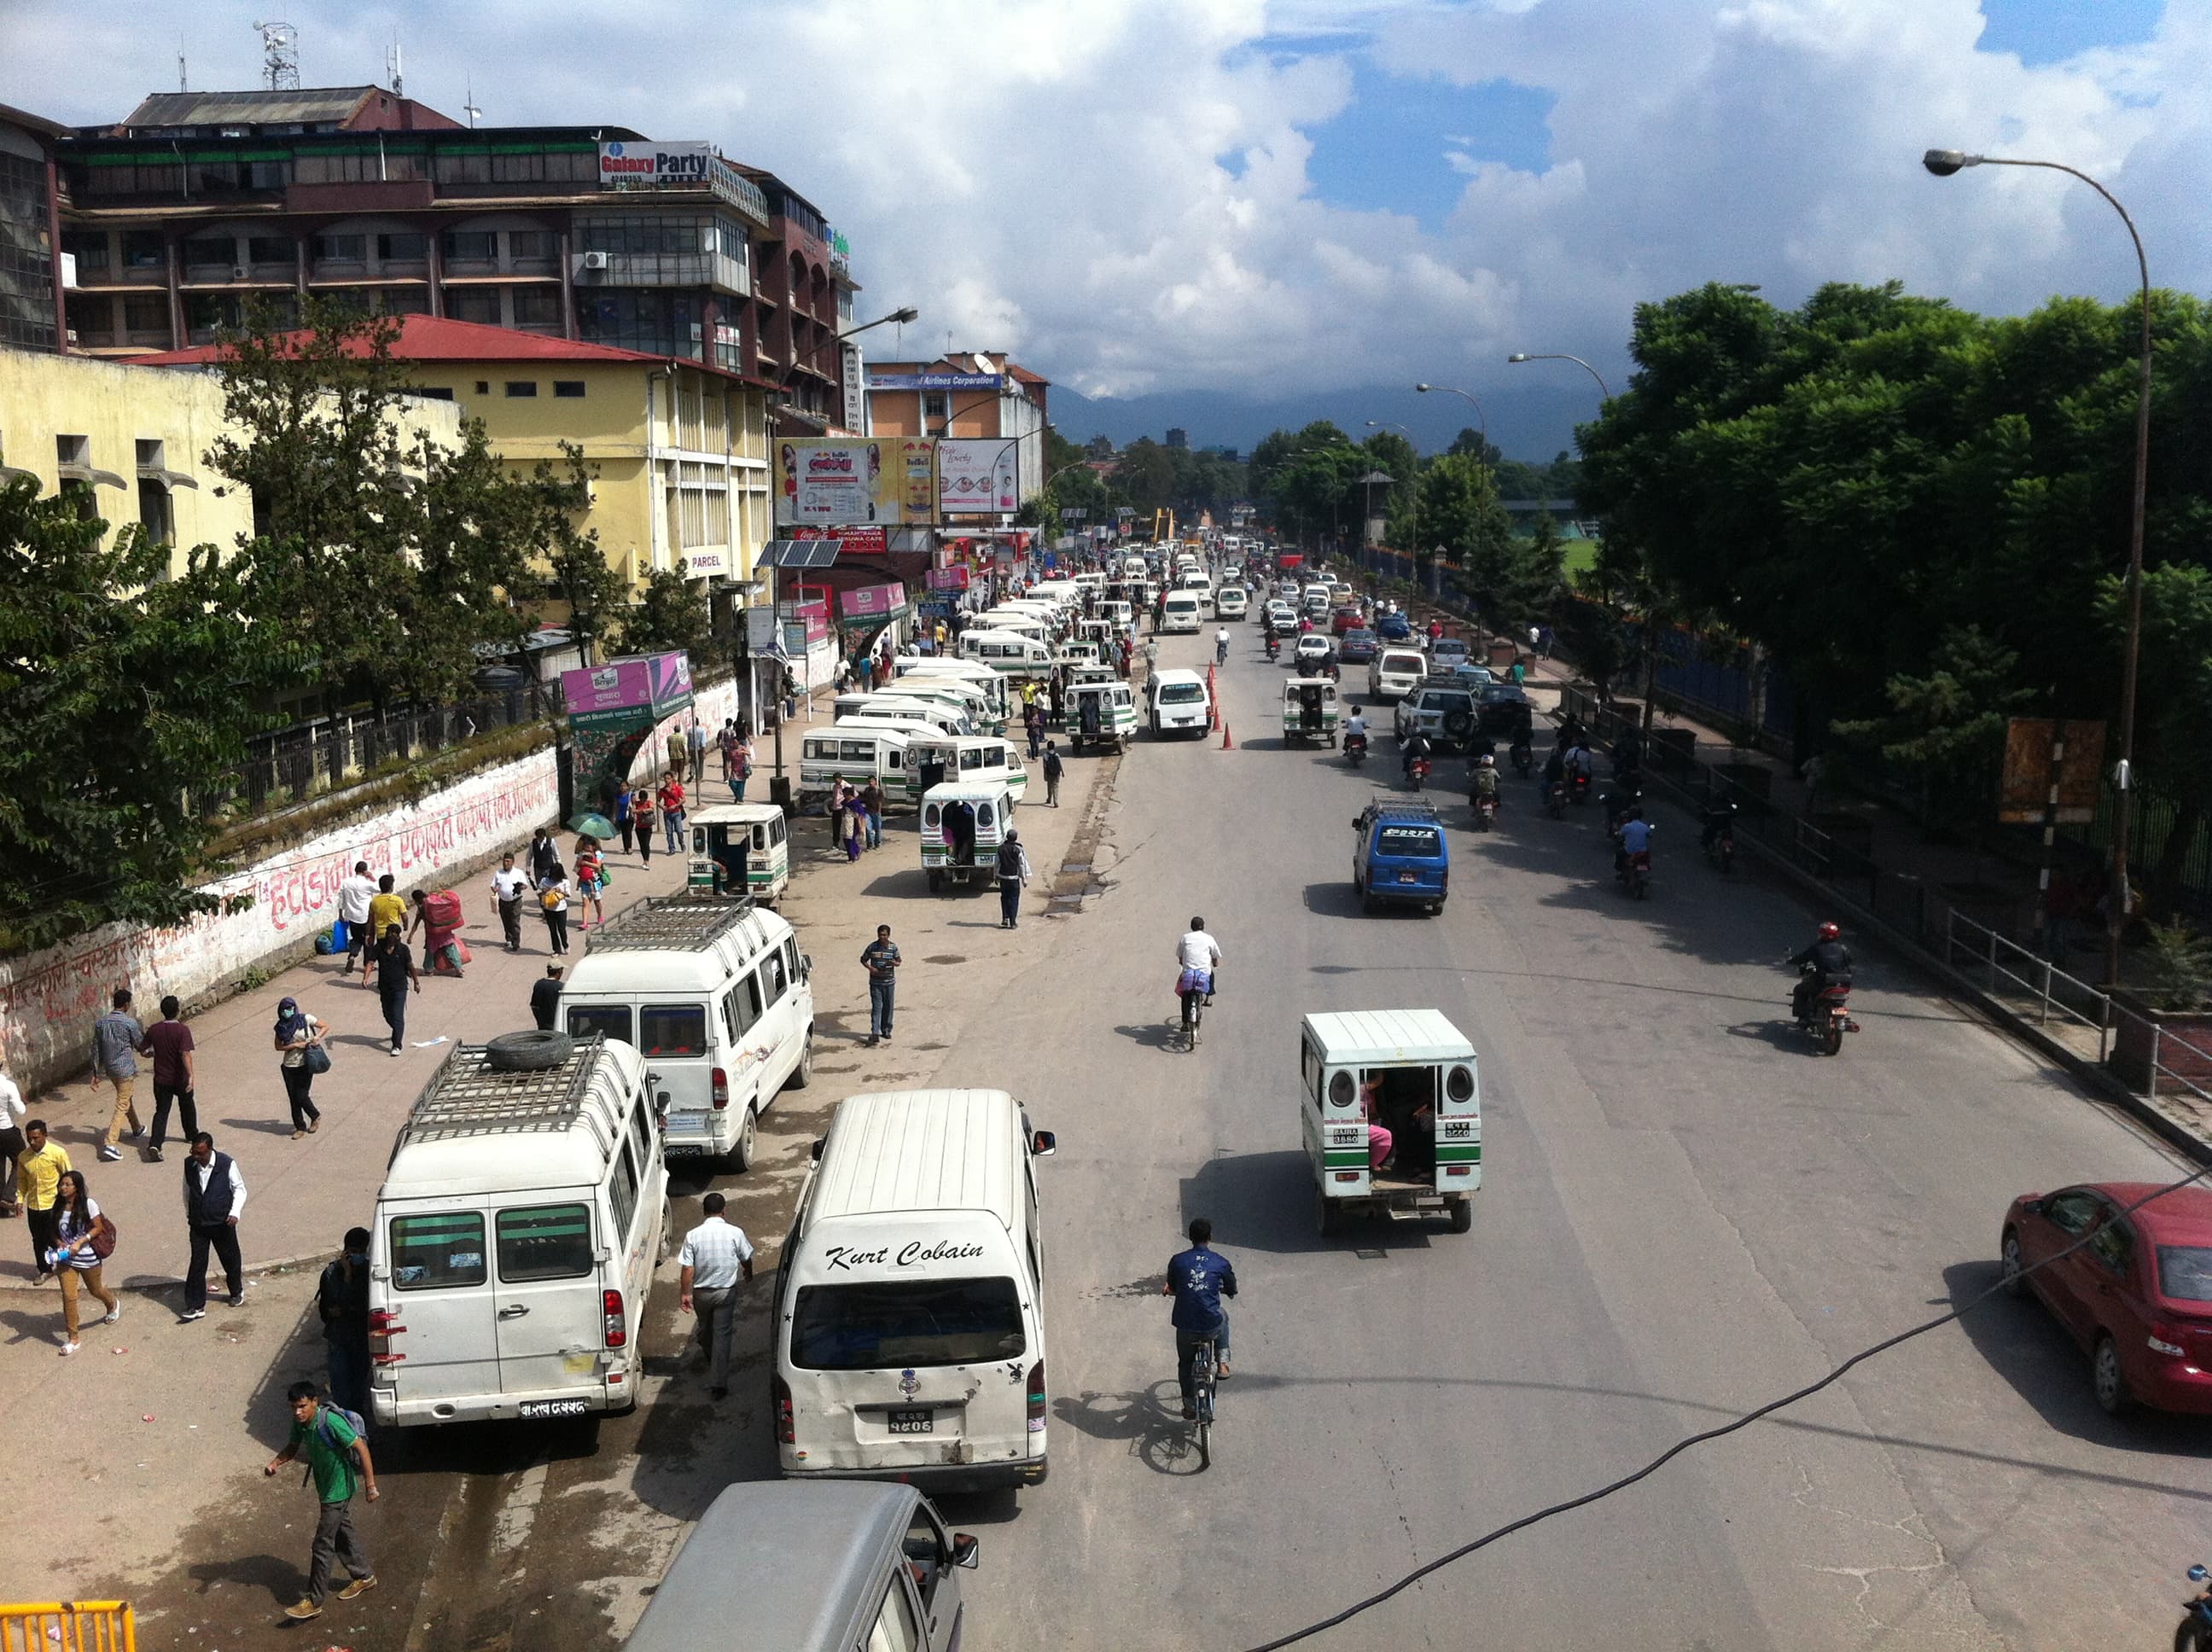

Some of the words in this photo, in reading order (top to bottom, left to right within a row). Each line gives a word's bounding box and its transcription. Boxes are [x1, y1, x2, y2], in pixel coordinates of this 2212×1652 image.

[602, 155, 655, 174] Galaxy
[655, 153, 707, 175] Party
[923, 376, 951, 385] Airlines
[952, 375, 994, 387] Corporation
[692, 556, 721, 568] PARCEL
[825, 1246, 888, 1271] Kurt
[896, 1239, 984, 1266] Cobain
